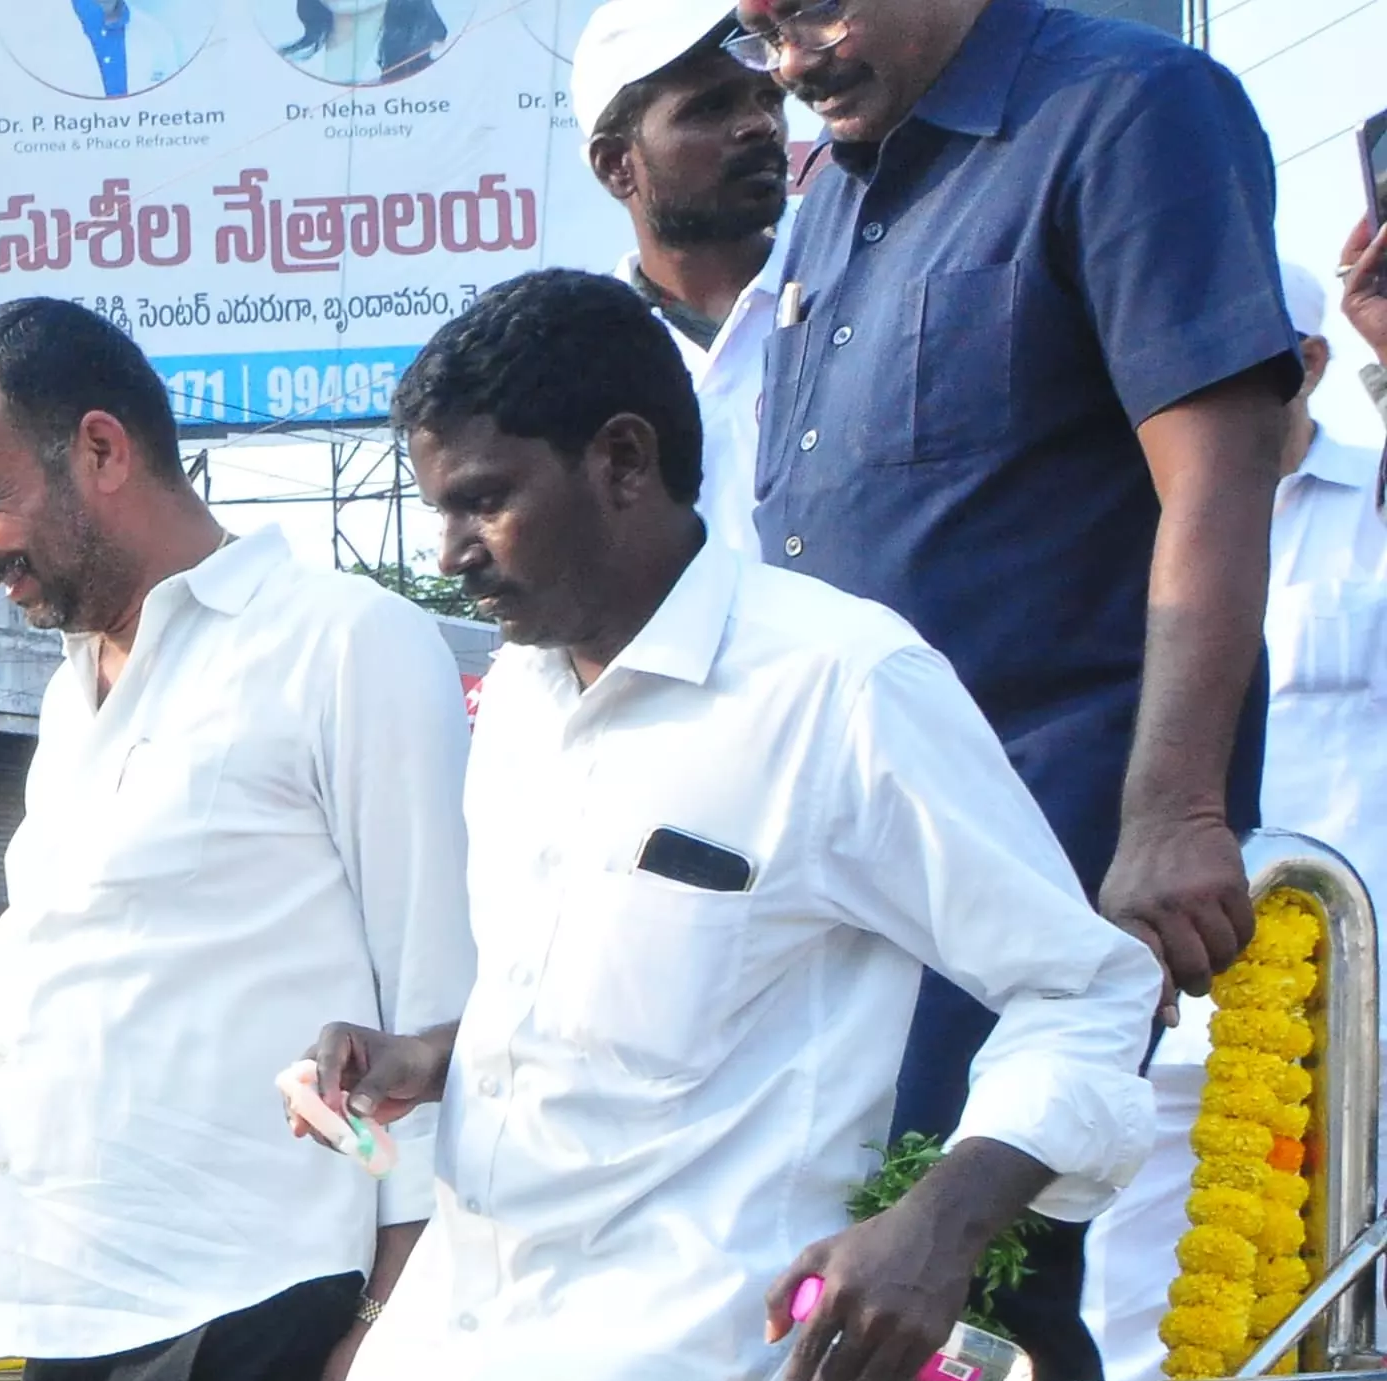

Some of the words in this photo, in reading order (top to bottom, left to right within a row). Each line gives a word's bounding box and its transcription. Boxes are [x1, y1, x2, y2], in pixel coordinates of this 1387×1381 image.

[286, 103, 313, 121] Dr.
[322, 100, 375, 119] Neha
[384, 98, 451, 116] Ghose
[518, 93, 545, 109] Dr.
[554, 91, 568, 108] P.
[32, 115, 45, 131] P.
[54, 112, 130, 134] Raghav
[138, 109, 226, 127] Preetam
[324, 122, 413, 139] Oculoplasty
[13, 140, 66, 153] Cornea
[70, 139, 80, 151] &
[86, 135, 130, 151] Phaco
[136, 133, 210, 148] Refractive
[212, 167, 537, 273] నేత్రాలయ
